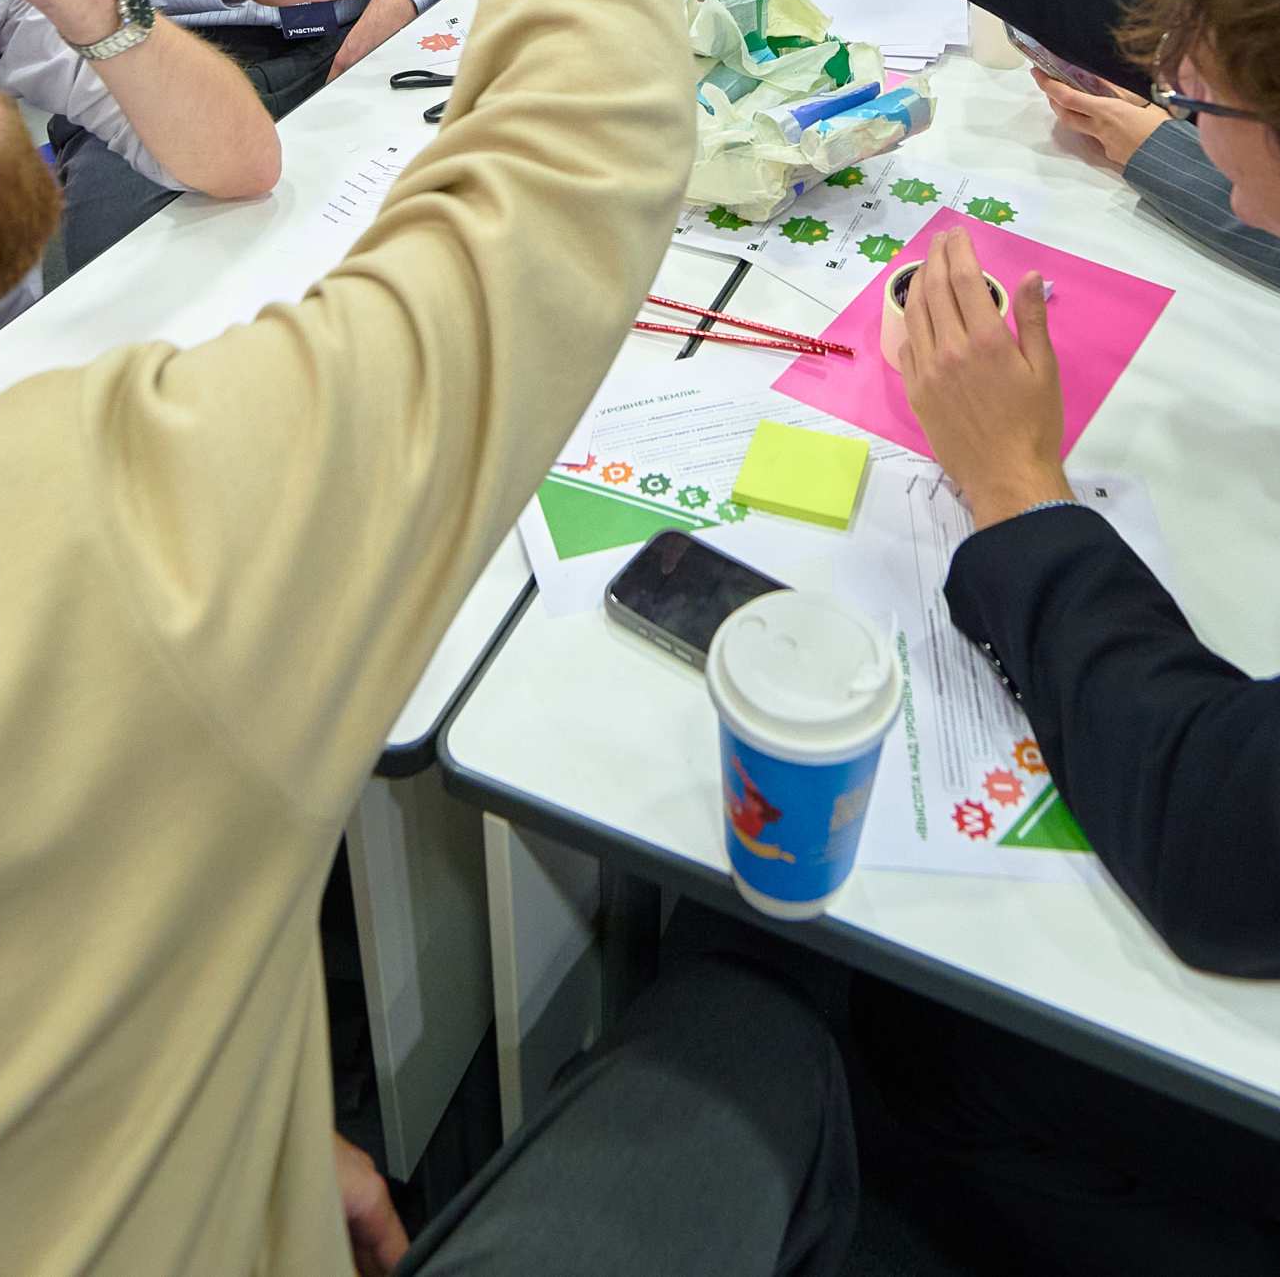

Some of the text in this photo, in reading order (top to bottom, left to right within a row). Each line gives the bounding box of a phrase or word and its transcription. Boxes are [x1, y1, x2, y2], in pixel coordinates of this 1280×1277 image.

[288, 26, 326, 37] участник
[600, 398, 654, 415] УРОВНЕМ
[611, 466, 738, 517] D G E T
[902, 679, 918, 740] УРОВНЕМ
[965, 806, 985, 833] W
